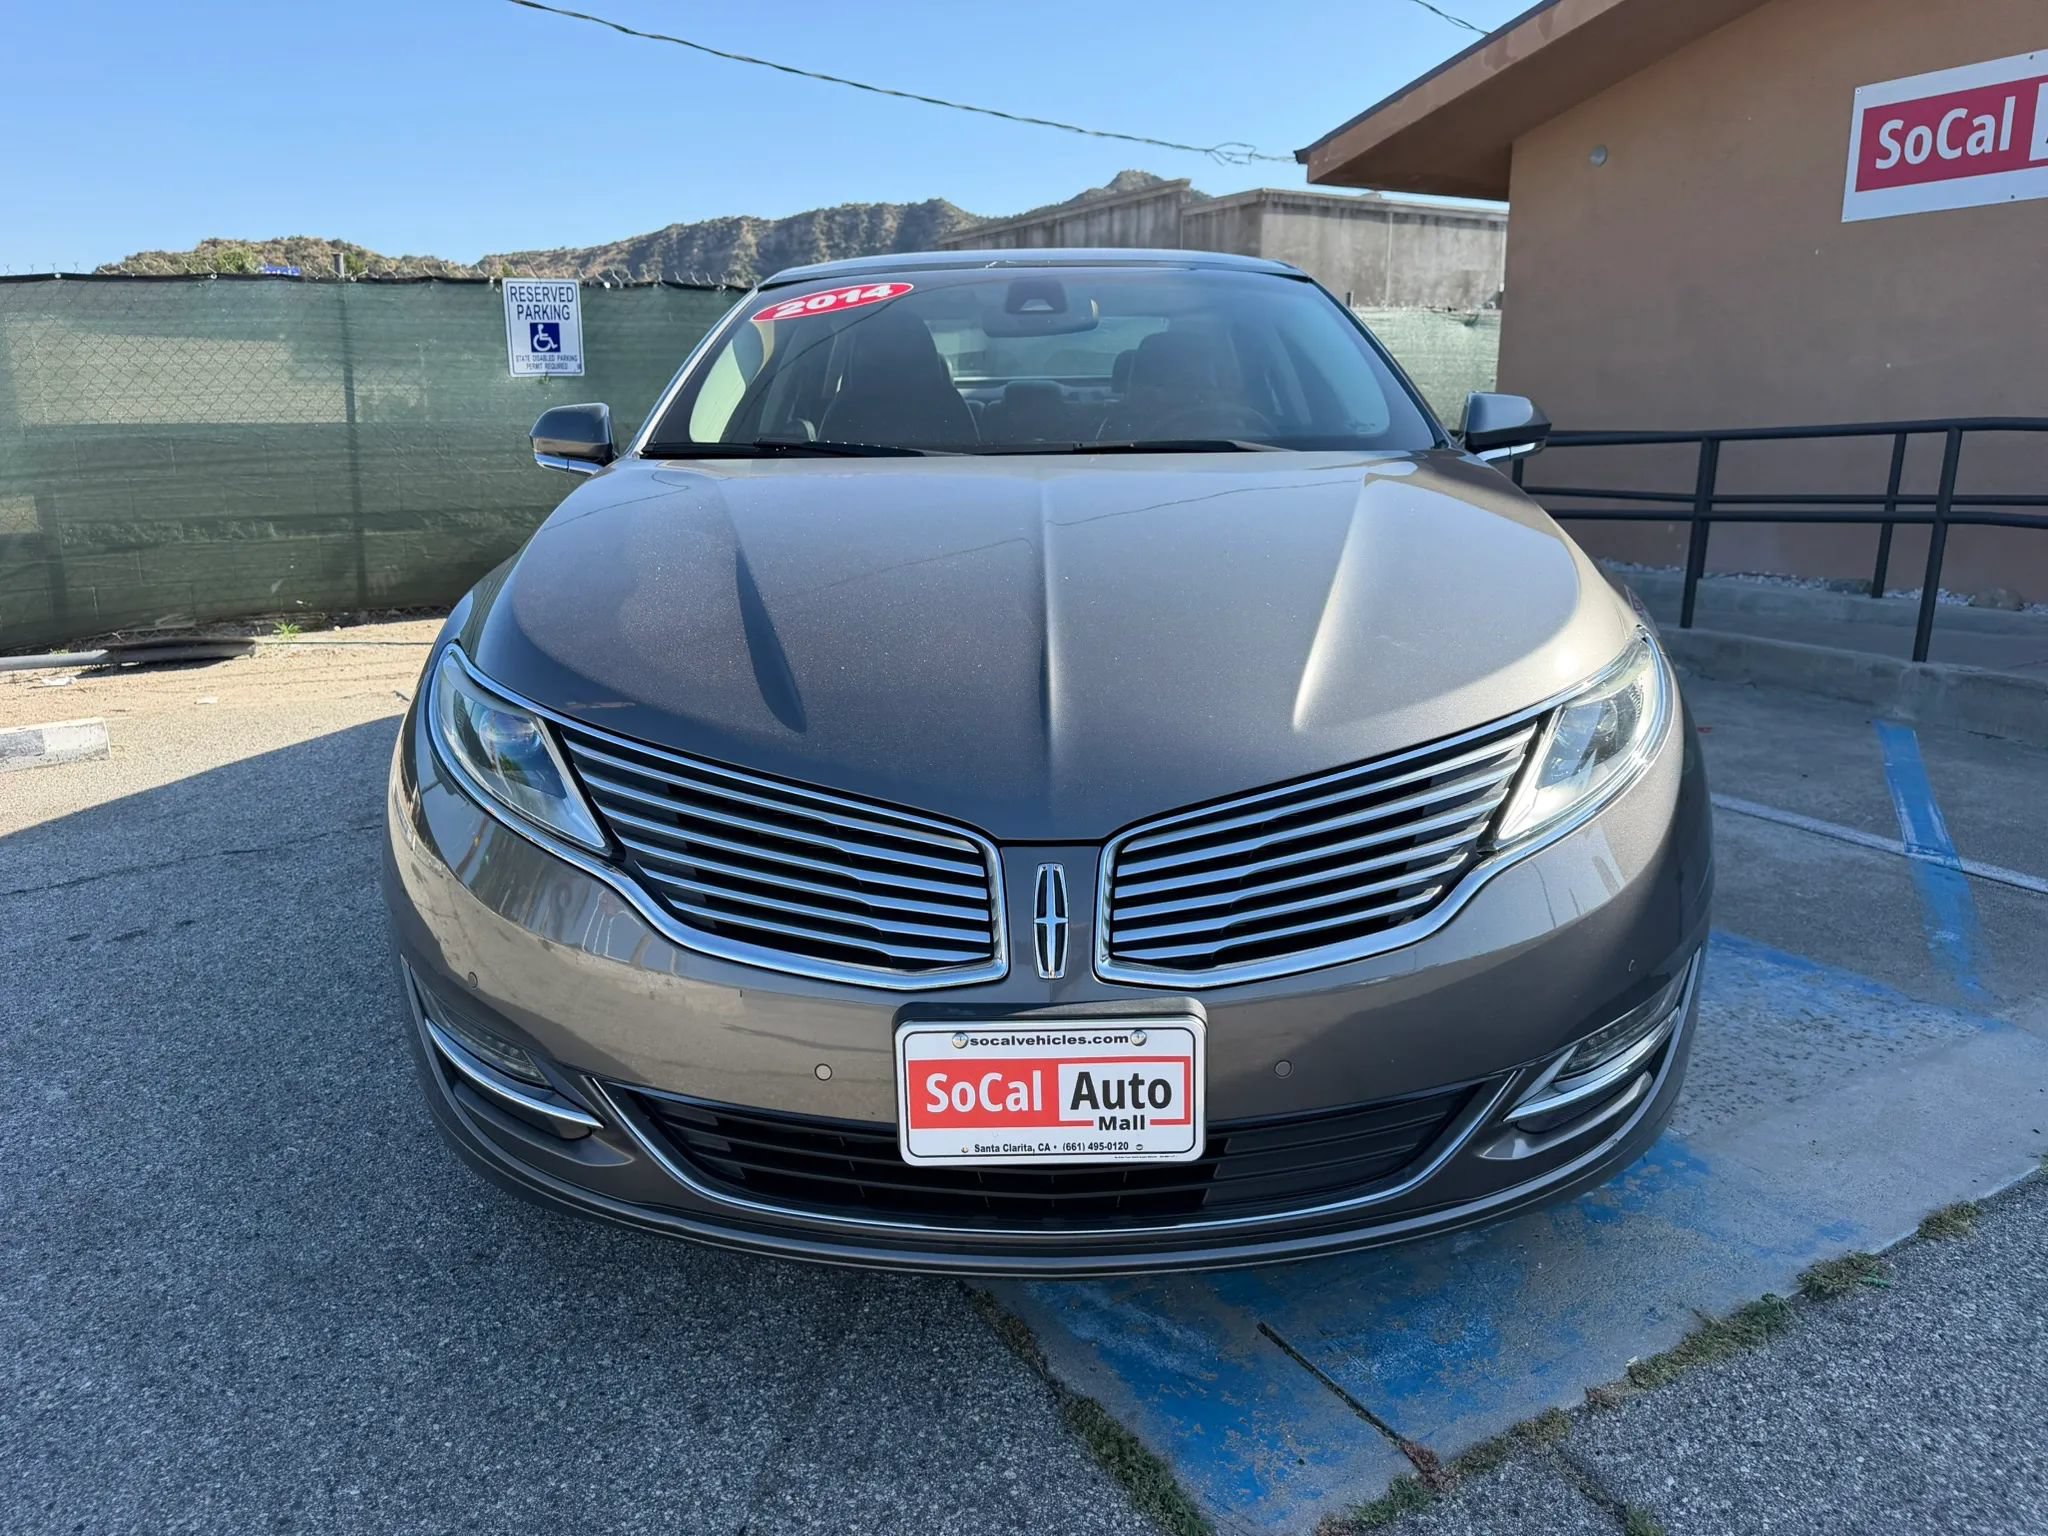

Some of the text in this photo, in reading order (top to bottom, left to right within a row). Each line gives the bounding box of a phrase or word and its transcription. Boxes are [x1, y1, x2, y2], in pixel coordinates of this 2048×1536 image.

[1875, 96, 2016, 169] SoCal
[509, 286, 574, 303] RESERVED
[773, 284, 893, 318] 2014
[517, 304, 570, 321] PARKING
[526, 362, 543, 370] PERMIT
[545, 362, 568, 370] REQUIRED
[557, 354, 578, 362] PARKING
[969, 1033, 1129, 1047] socalvehicles.com
[926, 1070, 1172, 1113] SoCal Auto
[1098, 1115, 1145, 1131] Mall
[974, 1141, 1129, 1154] Santa Clarita, CA (661) 495-0120
